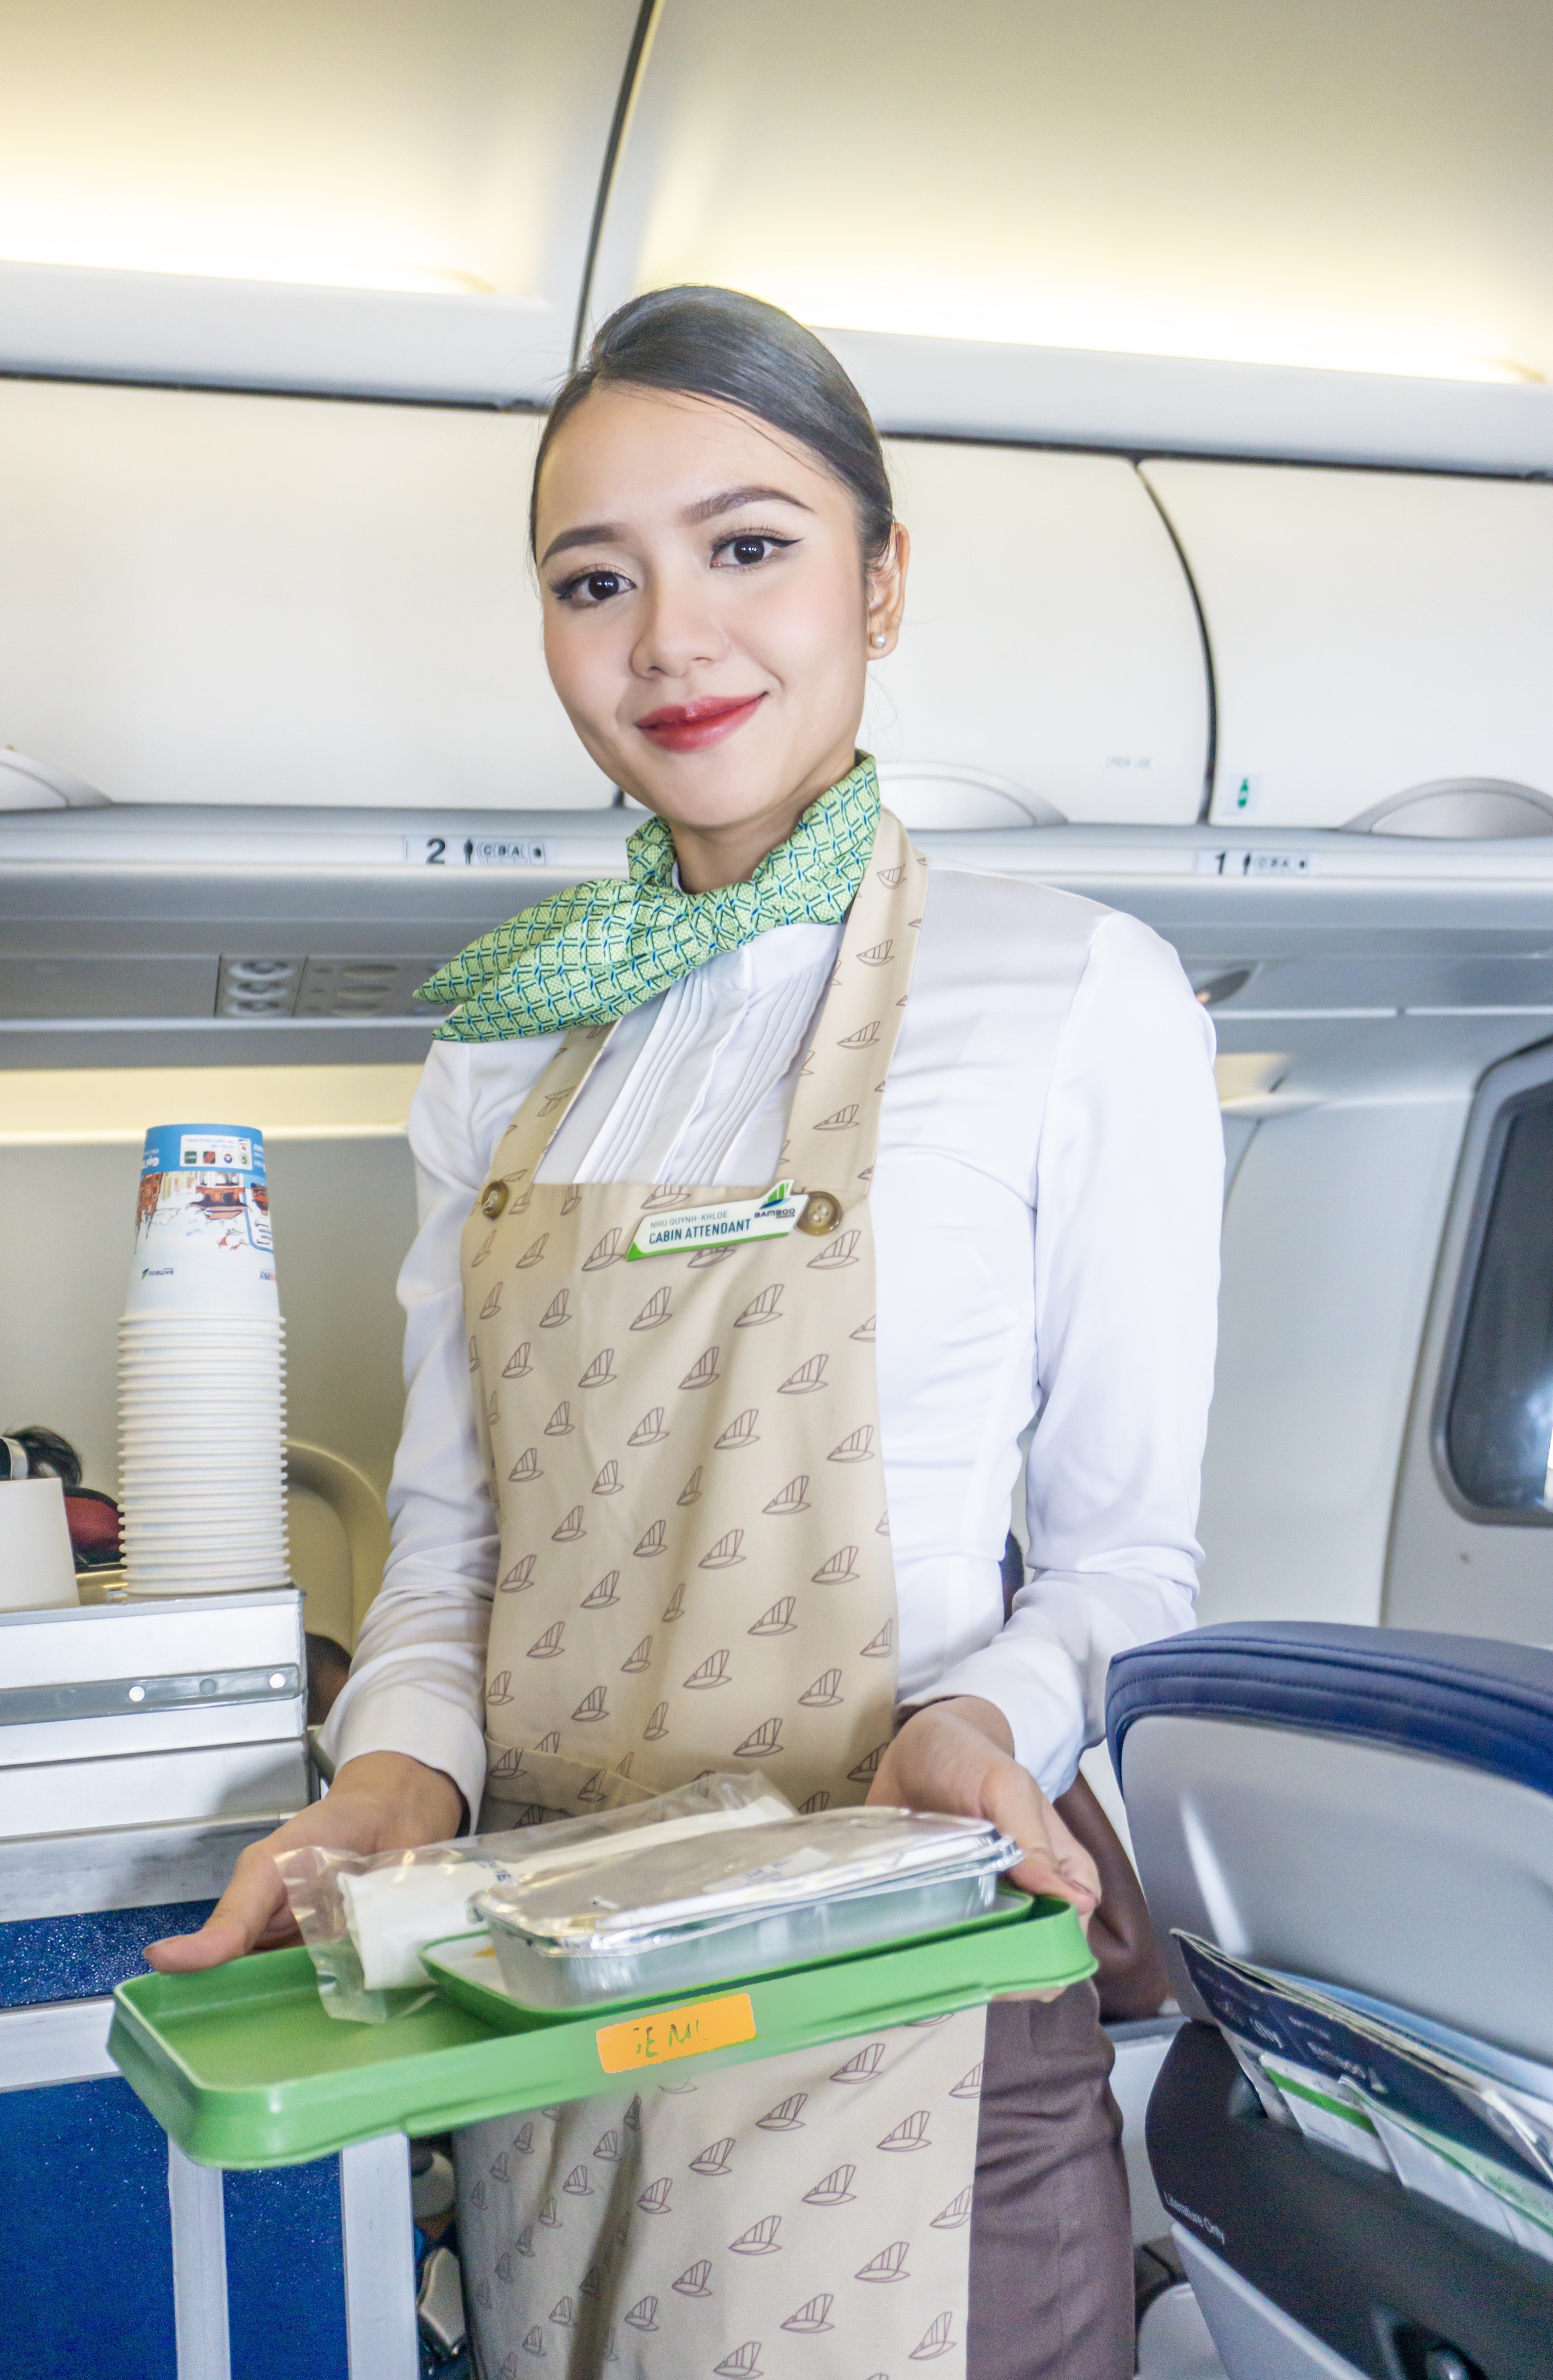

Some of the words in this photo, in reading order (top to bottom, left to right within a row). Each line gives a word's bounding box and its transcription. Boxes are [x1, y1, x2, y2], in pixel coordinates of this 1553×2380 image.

[426, 837, 446, 865] 2
[1216, 850, 1226, 875] 1
[650, 1220, 667, 1229] NHU
[669, 1211, 728, 1226] QUYNH-KHLOE
[755, 1208, 795, 1219] BAMBOO
[649, 1228, 682, 1245] CABIN
[685, 1219, 751, 1239] ATTENDANT
